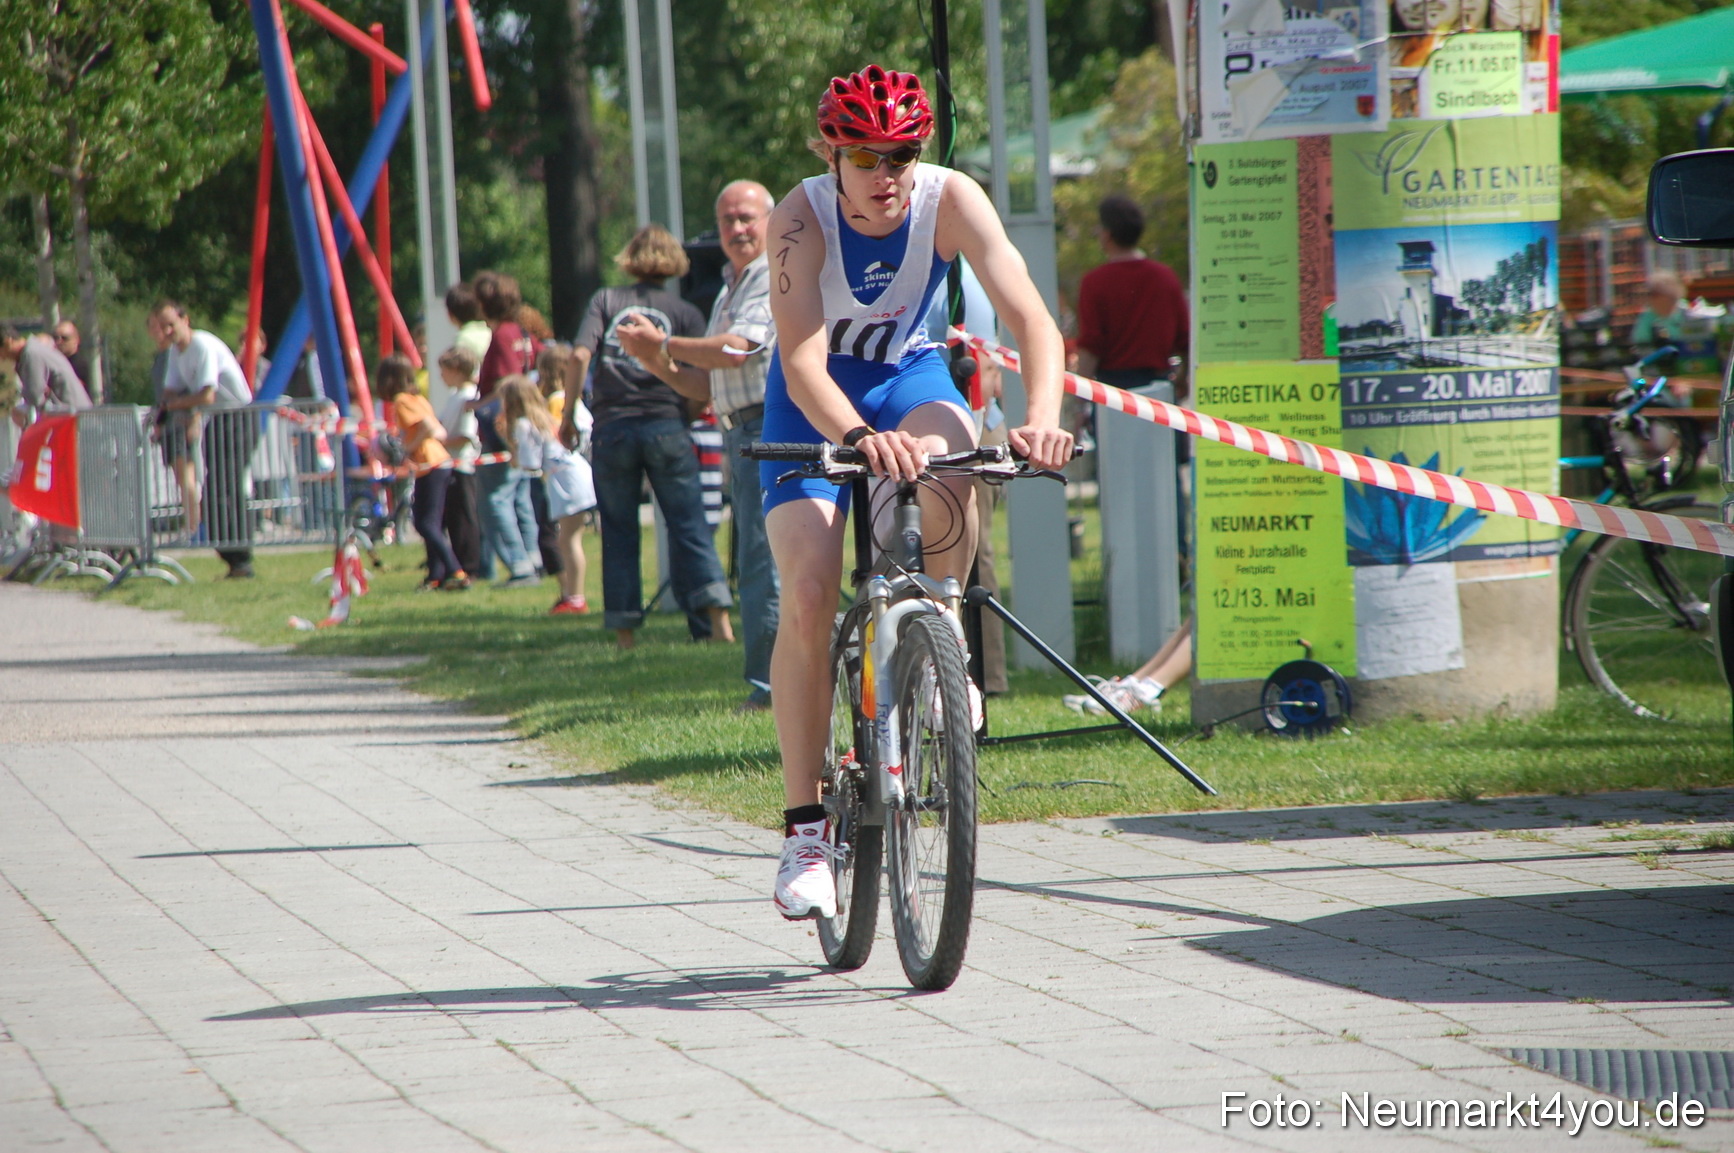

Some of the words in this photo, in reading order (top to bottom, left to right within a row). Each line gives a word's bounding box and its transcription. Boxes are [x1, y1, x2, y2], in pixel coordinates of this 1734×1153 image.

[1340, 78, 1369, 91] 2007
[1436, 87, 1518, 108] Sindlbach
[1259, 211, 1282, 221] 2007
[865, 282, 876, 290] SV
[1350, 377, 1390, 402] 17.
[1422, 374, 1462, 400] 20.
[1467, 370, 1513, 398] Mai
[1514, 368, 1552, 396] 2007
[1198, 384, 1302, 405] ENERGETIKA
[1310, 382, 1341, 402] 07
[1279, 412, 1326, 421] Wellness
[1350, 412, 1366, 425] 10
[1369, 410, 1393, 424] Uhr
[1397, 408, 1457, 425] Eröffnung
[1211, 514, 1314, 532] NEUMARKT
[1215, 546, 1246, 558] Kleine
[1248, 545, 1308, 559] Jurahalle
[1235, 564, 1276, 575] Festplatz
[1213, 587, 1269, 609] 12./13.
[1275, 587, 1316, 608] Mai
